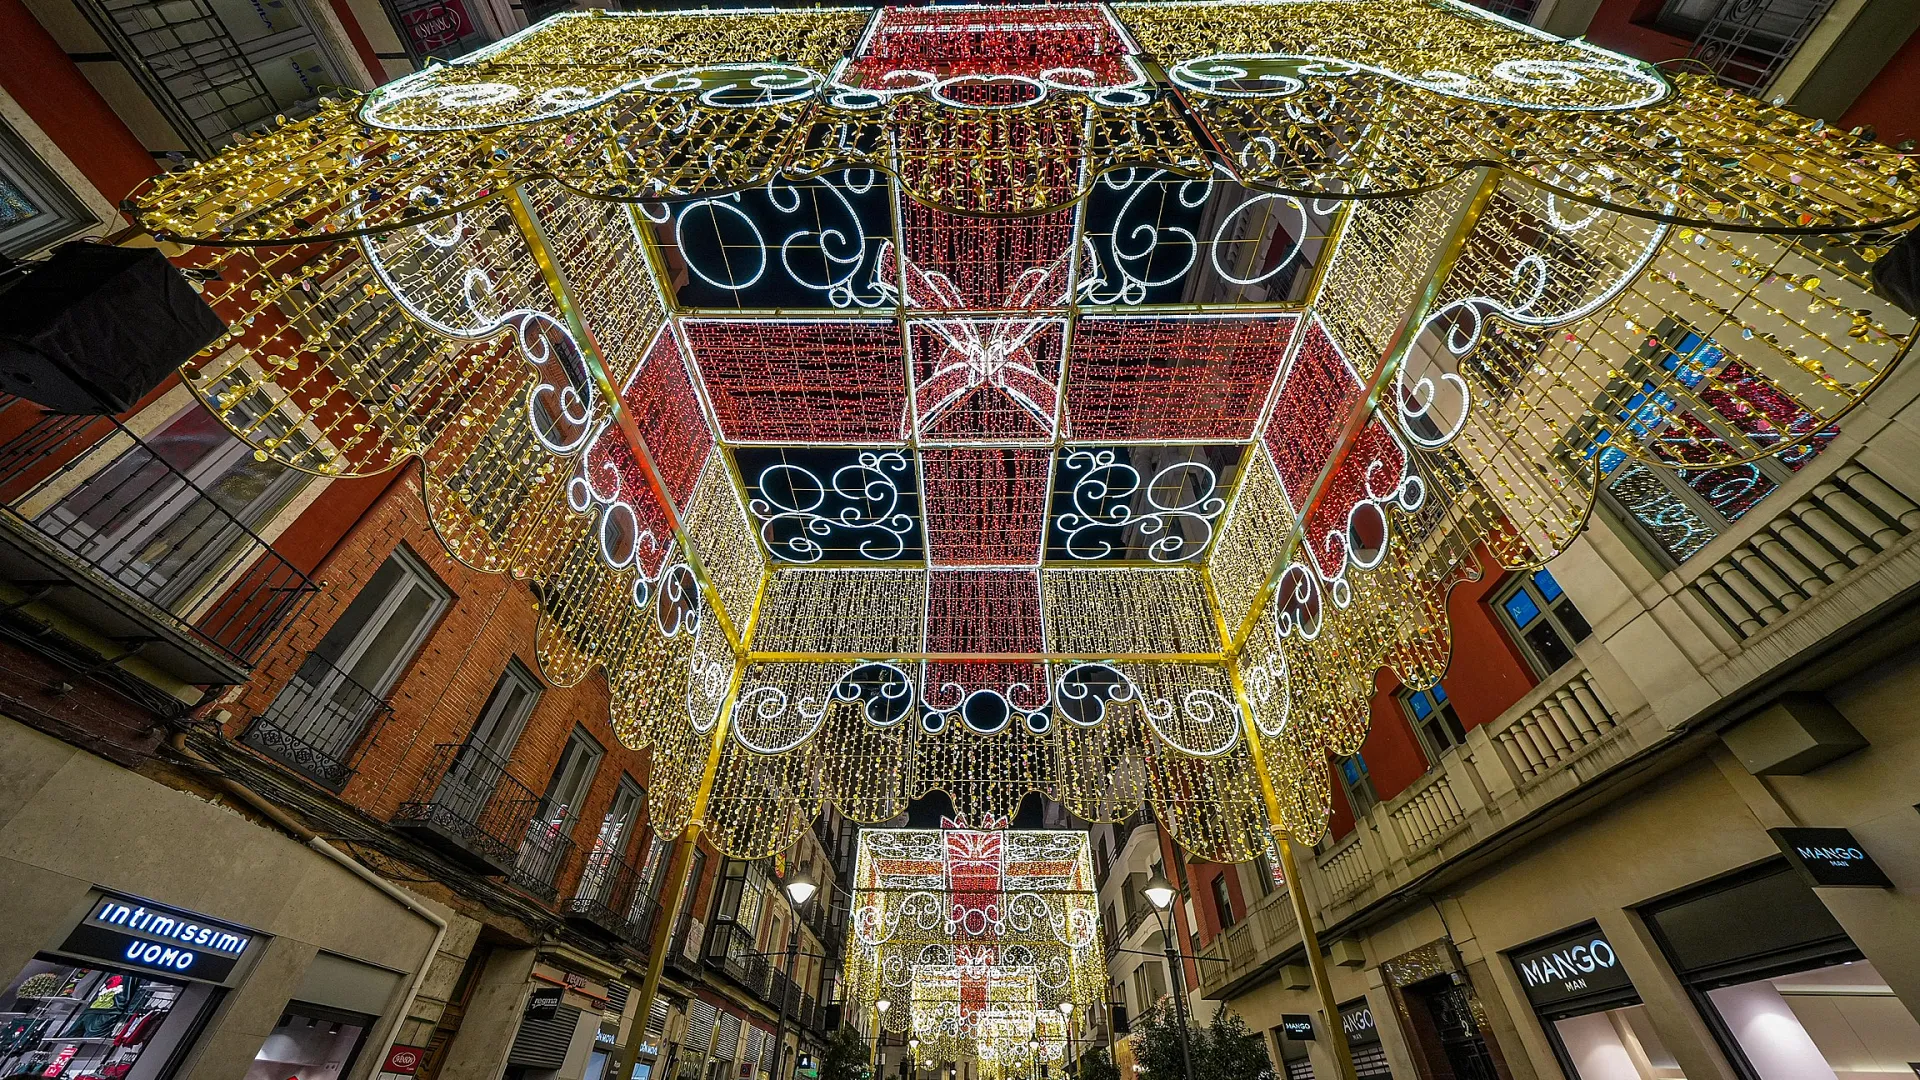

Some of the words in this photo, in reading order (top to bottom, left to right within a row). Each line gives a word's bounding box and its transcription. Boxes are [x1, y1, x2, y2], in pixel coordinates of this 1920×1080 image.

[1796, 846, 1864, 860] MANGO
[98, 902, 248, 954] intimissimi
[126, 940, 194, 969] UOMO
[1520, 938, 1616, 987] MANGO
[1564, 977, 1588, 992] MAN
[534, 997, 558, 1005] regma
[1285, 1022, 1311, 1030] MANGO
[1342, 1008, 1374, 1034] ANGO
